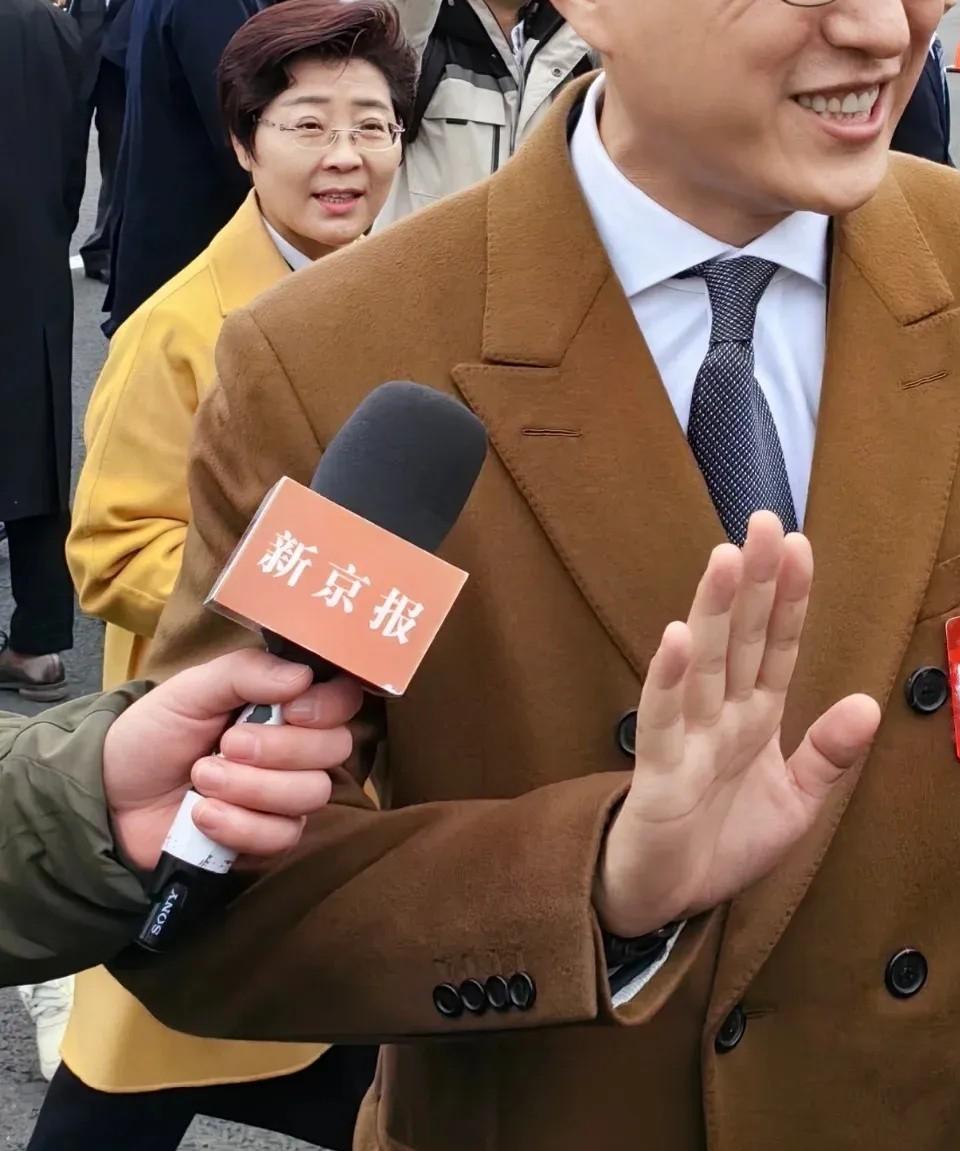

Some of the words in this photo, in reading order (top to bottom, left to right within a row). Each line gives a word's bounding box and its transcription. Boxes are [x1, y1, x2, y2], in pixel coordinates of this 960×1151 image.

[256, 530, 425, 645] 新京报
[151, 888, 179, 936] SONY
